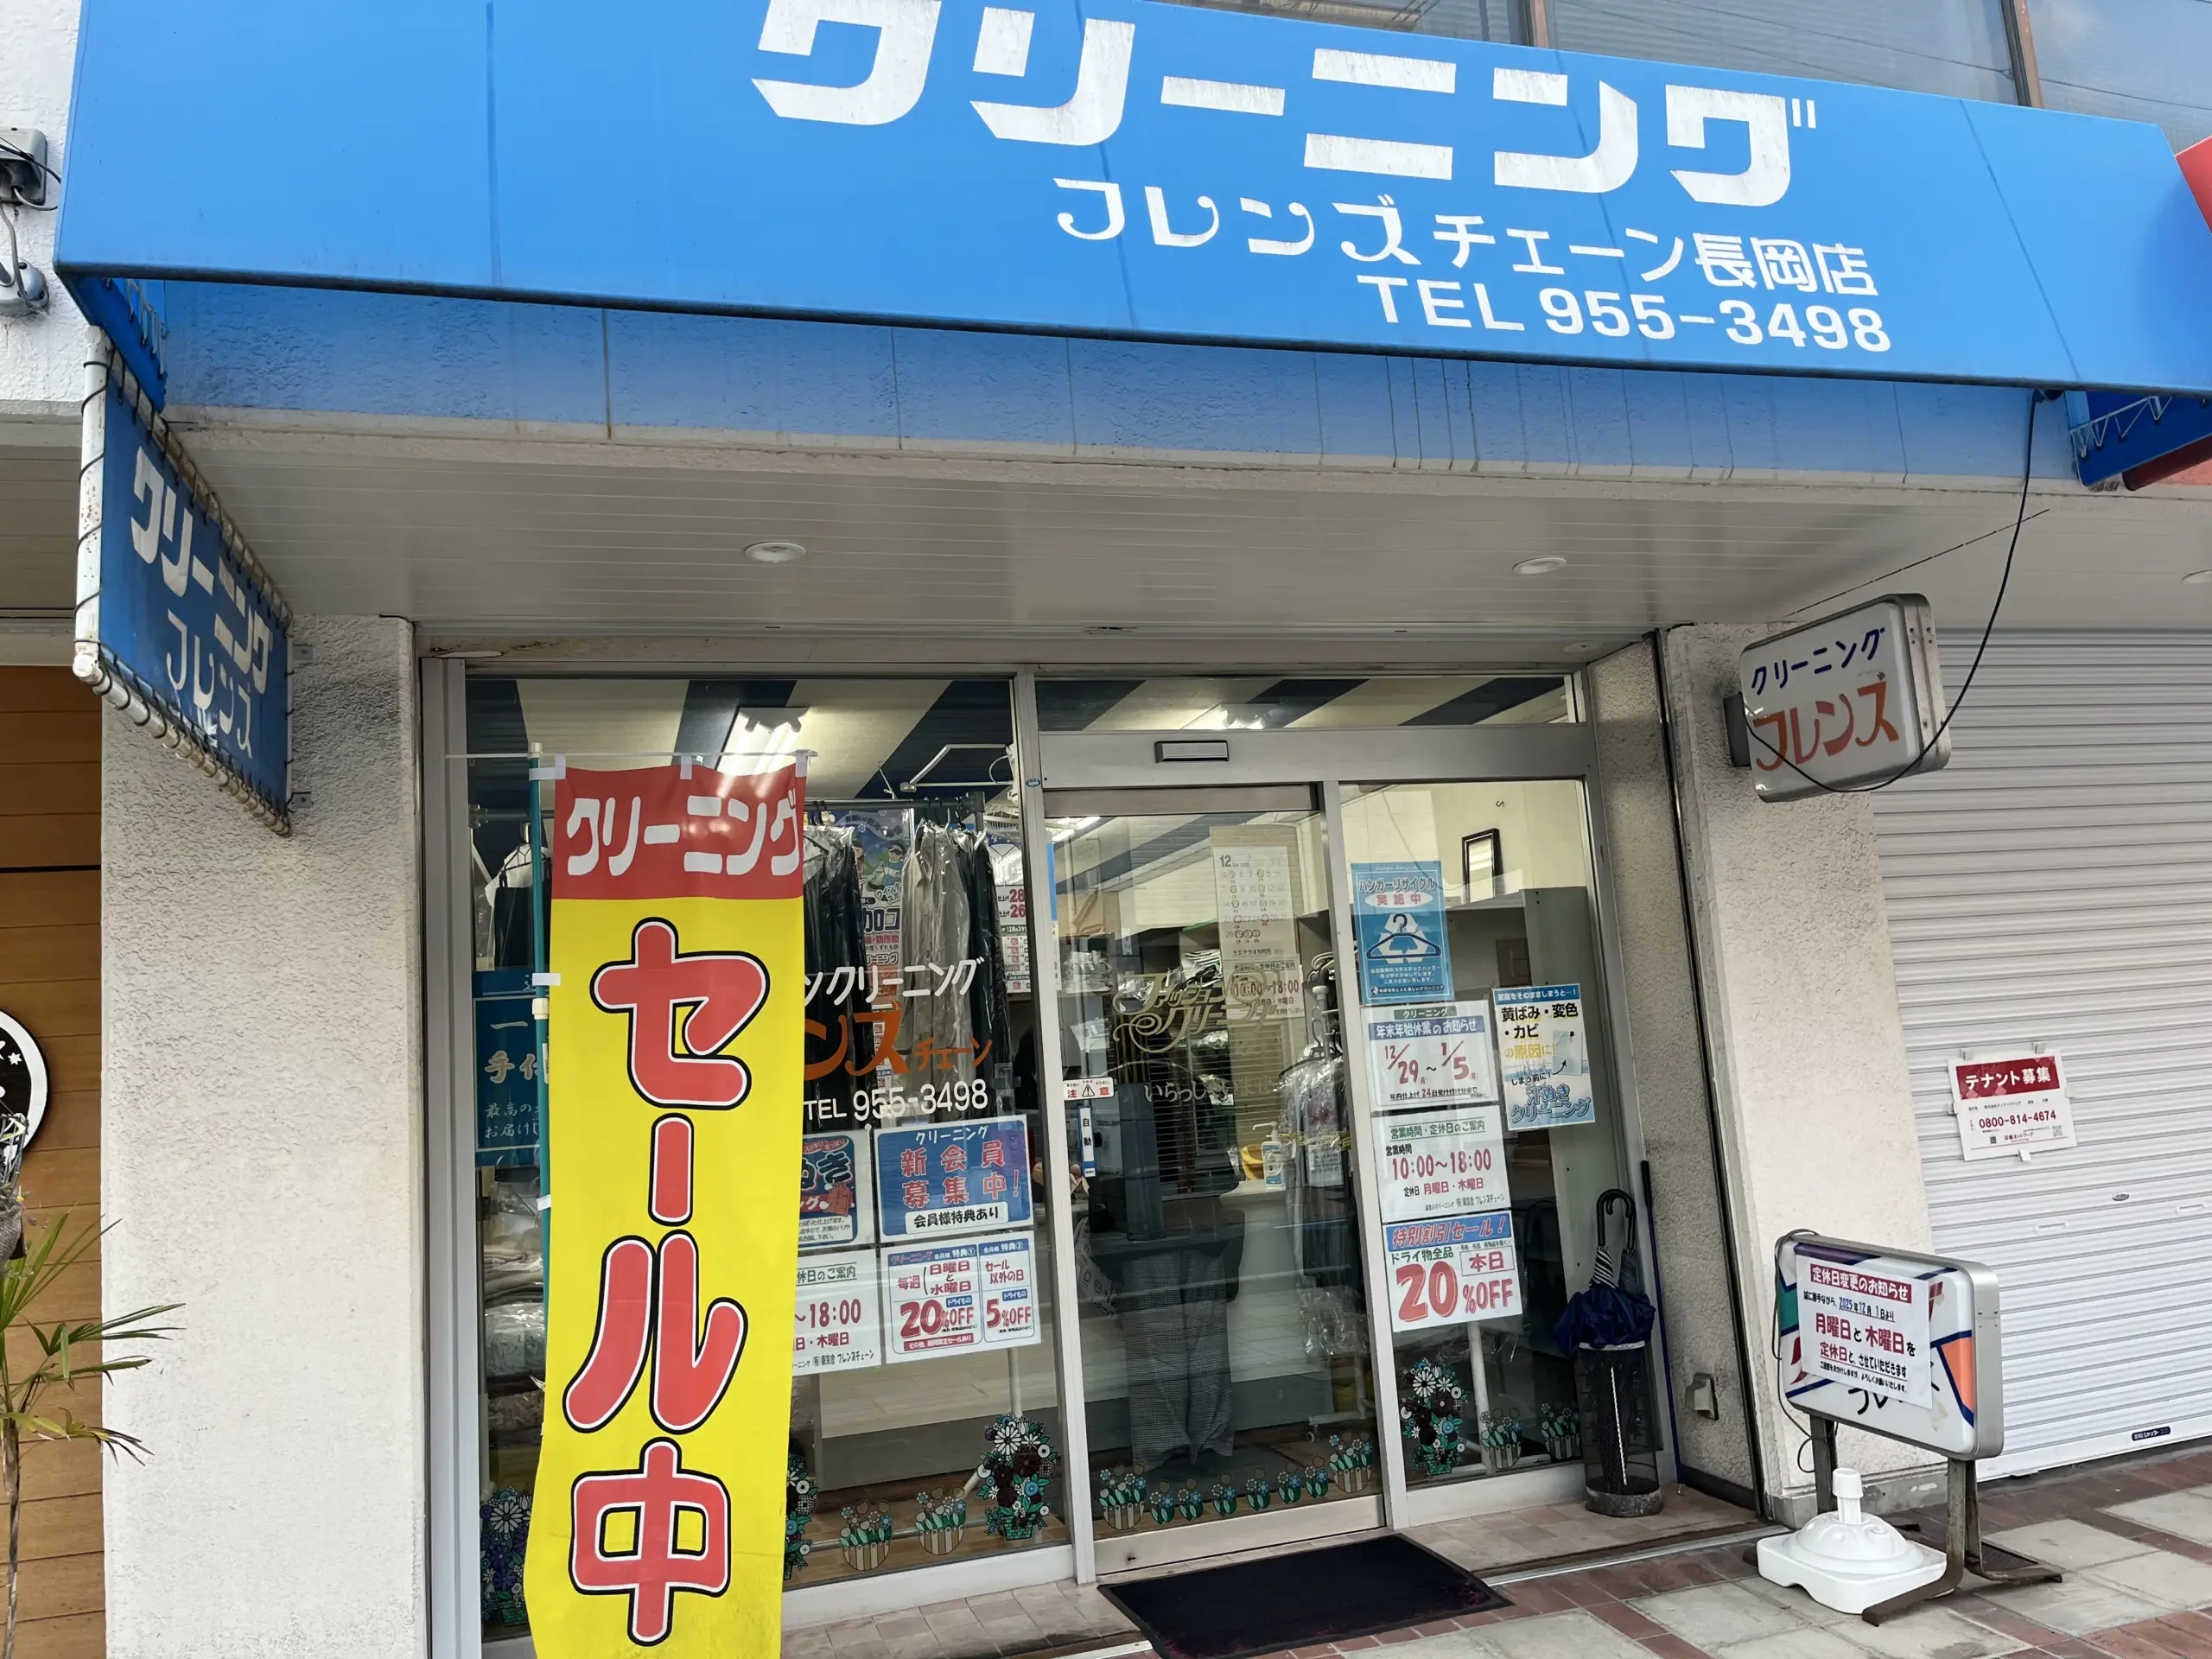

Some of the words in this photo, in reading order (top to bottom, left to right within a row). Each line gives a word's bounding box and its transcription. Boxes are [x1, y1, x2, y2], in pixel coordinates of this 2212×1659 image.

[751, 0, 1816, 207] クリーニング
[1357, 274, 1525, 332] TEL
[1538, 287, 1891, 353] 955-3498
[130, 445, 273, 694] クリーニング
[1751, 626, 1885, 695] クリーニング
[1752, 671, 1899, 772] フレンズ
[566, 786, 801, 876] クリーニング
[1359, 877, 1437, 893] ハンガーリサイクル
[1376, 893, 1421, 906] 実施中
[1402, 1007, 1448, 1019] クリーニング
[1501, 1002, 1580, 1022] 黄ばみ・変色
[914, 1037, 993, 1071] チェーン
[1965, 1066, 2051, 1090] テナント募集
[804, 1098, 847, 1121] TEL
[853, 1078, 988, 1122] 955-3498
[1525, 1083, 1571, 1106] 汗ぬき
[1511, 1096, 1592, 1123] クリーニング
[1979, 1109, 2056, 1128] 0800-814-4674
[916, 1125, 988, 1145] クリーニング
[1390, 1120, 1485, 1140] 営業時間・定休日のご案内
[1386, 1143, 1413, 1156] 営業時間
[1403, 1186, 1421, 1198] 定休日
[1423, 1178, 1484, 1195] 月曜日・木曜日
[914, 1206, 1000, 1229] 会員様特典あり
[985, 1258, 1009, 1272] セール
[1391, 1246, 1454, 1265] ドライ物全品
[1469, 1251, 1504, 1273] 本日
[563, 917, 770, 1647] セール中
[898, 1275, 921, 1290] 毎週
[929, 1261, 970, 1275] 日曜日
[989, 1268, 1025, 1285] 以外の日
[1812, 1266, 1909, 1301] 定休日変更のお知らせ
